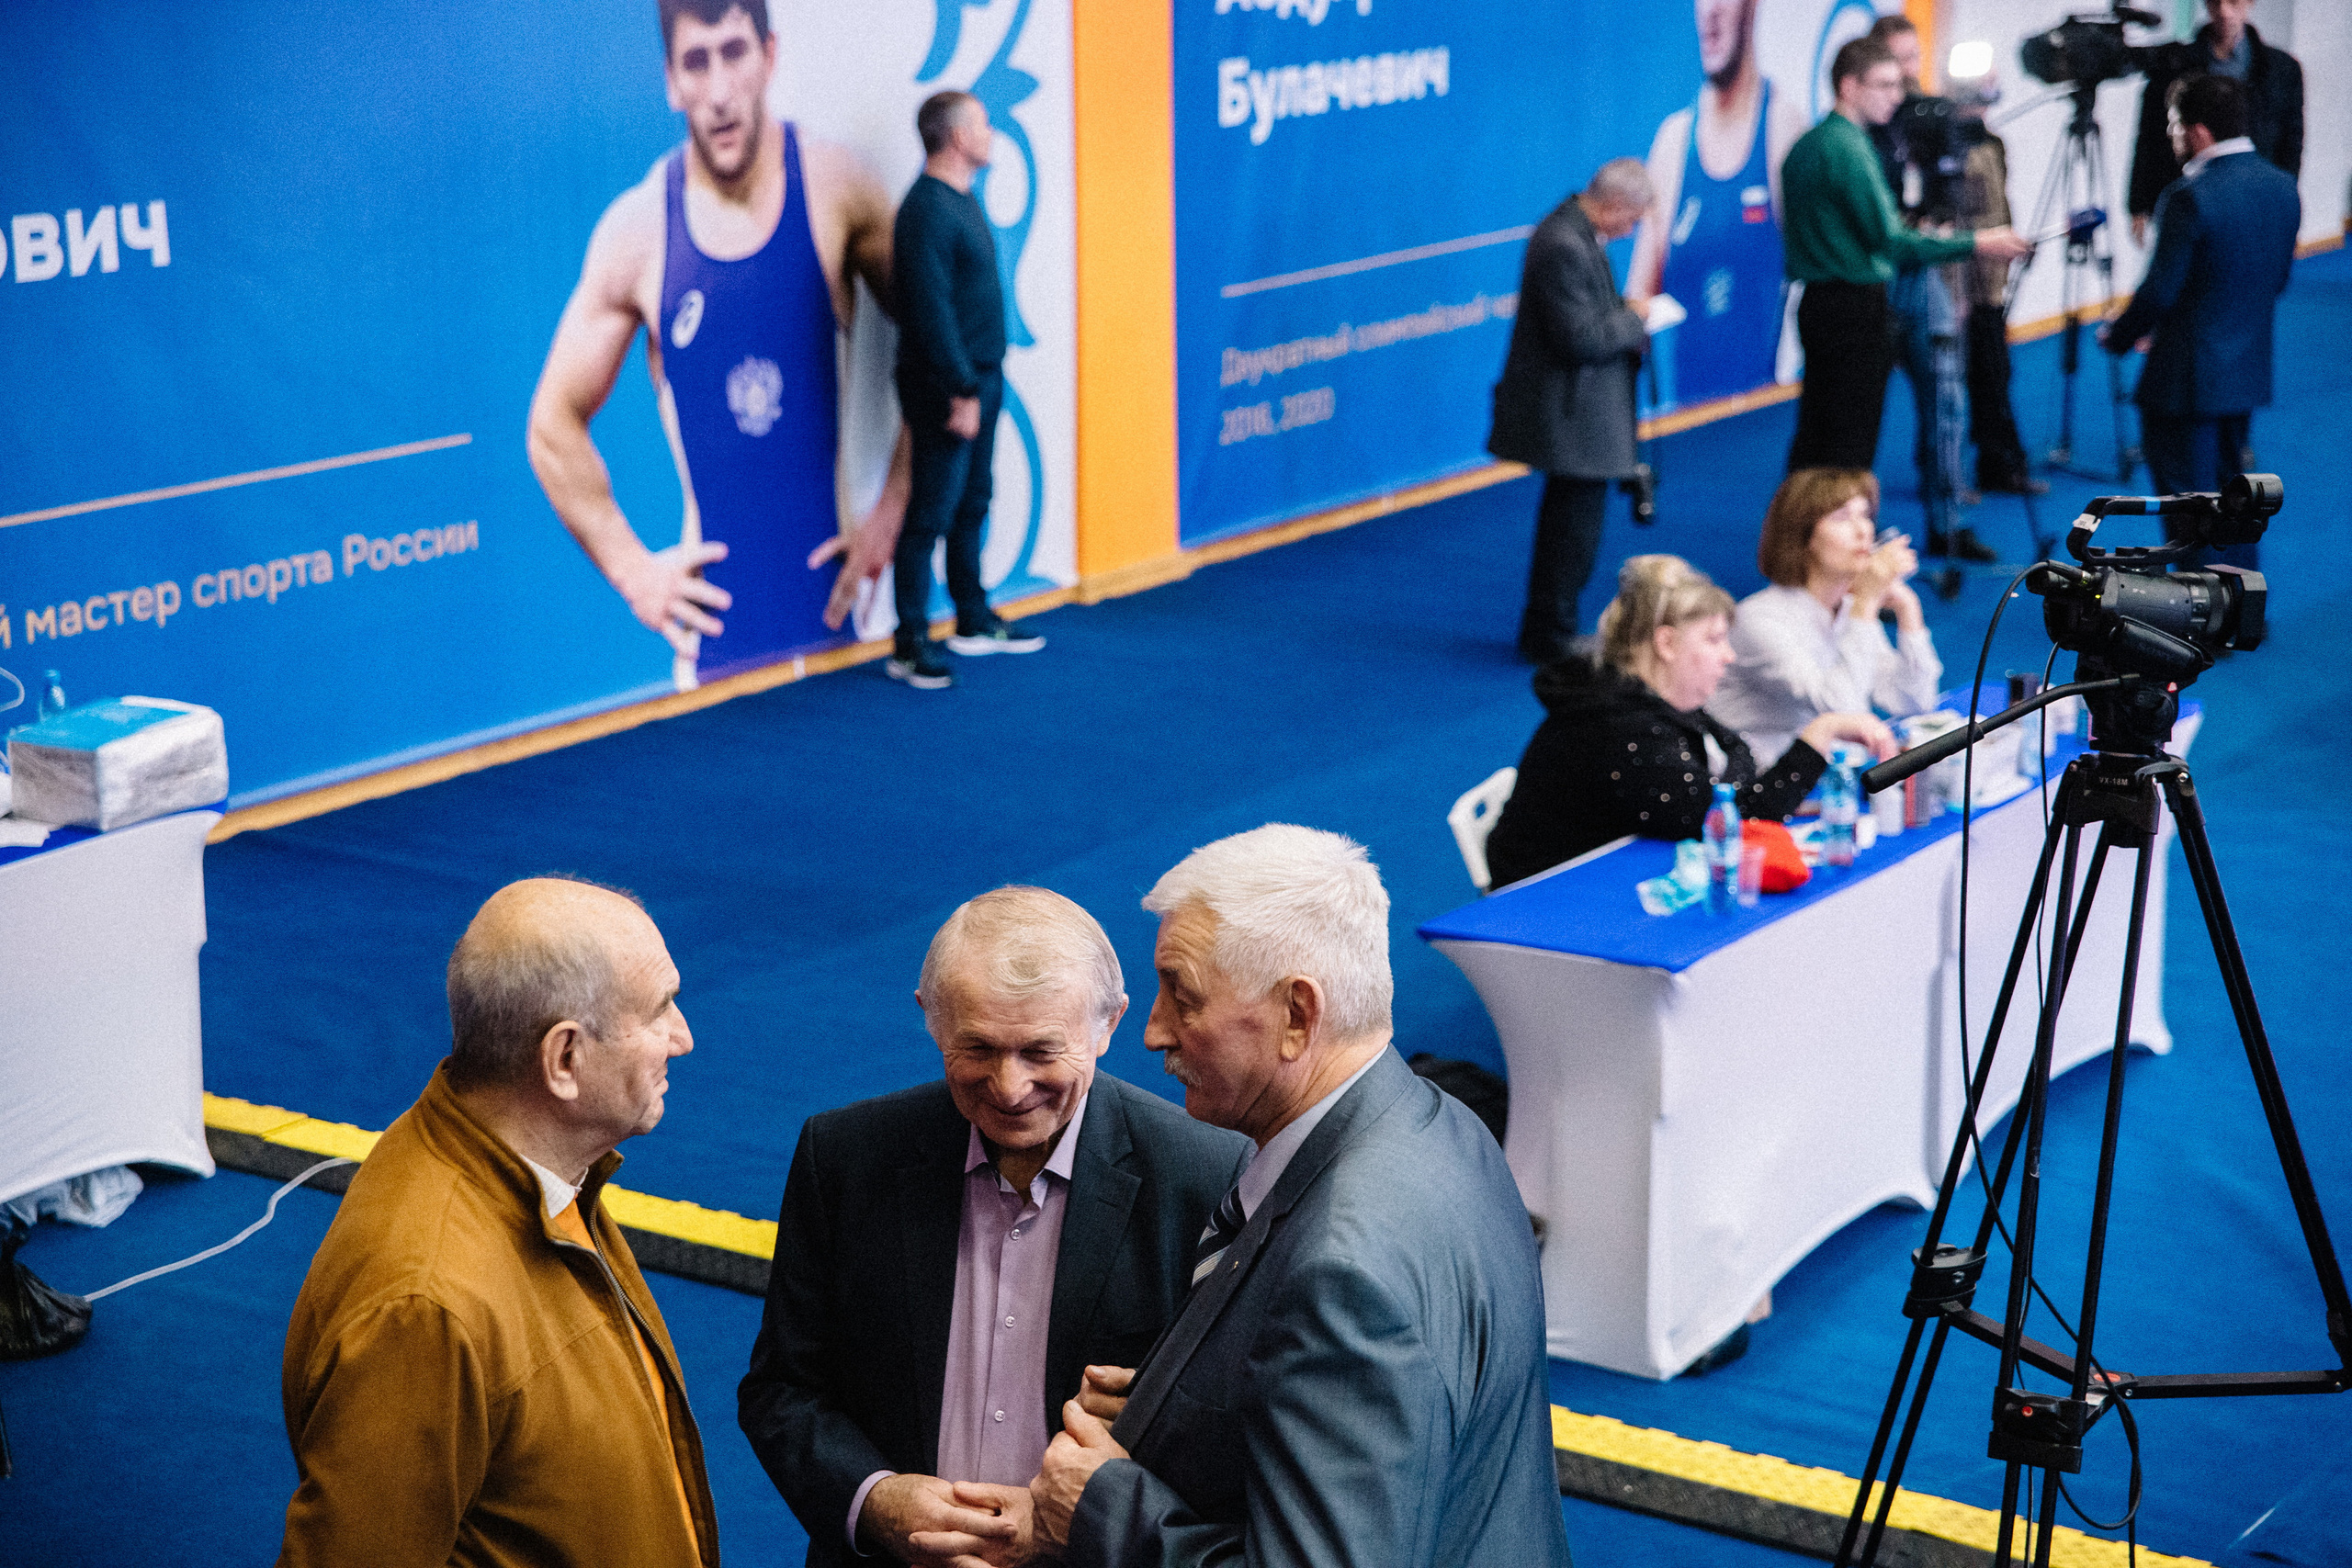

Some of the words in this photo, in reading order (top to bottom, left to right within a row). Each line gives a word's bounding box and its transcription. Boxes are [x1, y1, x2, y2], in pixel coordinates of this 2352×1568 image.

[1217, 45, 1451, 145] Булачевич
[0, 198, 171, 284] вич
[25, 581, 182, 645] мастер
[192, 549, 333, 608] спорта
[342, 520, 479, 577] России
